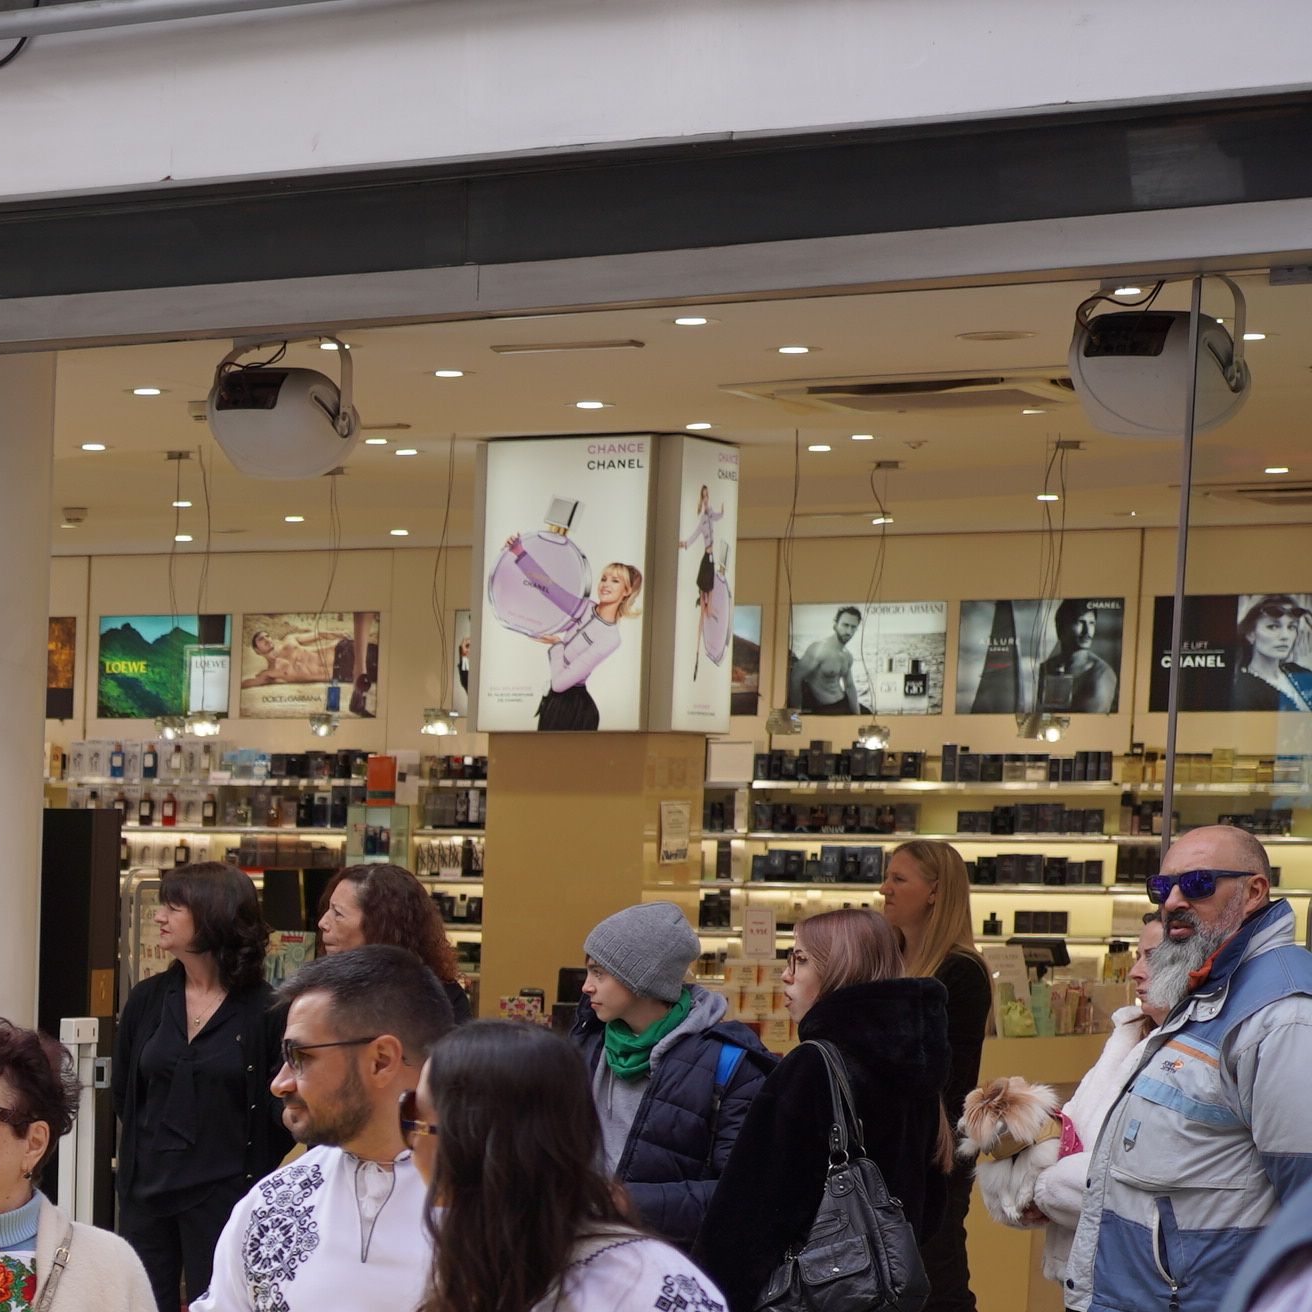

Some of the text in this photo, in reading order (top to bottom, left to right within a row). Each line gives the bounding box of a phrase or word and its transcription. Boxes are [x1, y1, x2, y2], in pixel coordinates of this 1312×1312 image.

[587, 442, 645, 455] CHANCE
[587, 458, 644, 471] CHANEL
[909, 604, 944, 615] ARMANI
[1086, 601, 1121, 610] CHANEL
[105, 661, 148, 674] LOEWE
[195, 659, 227, 669] LOEWE
